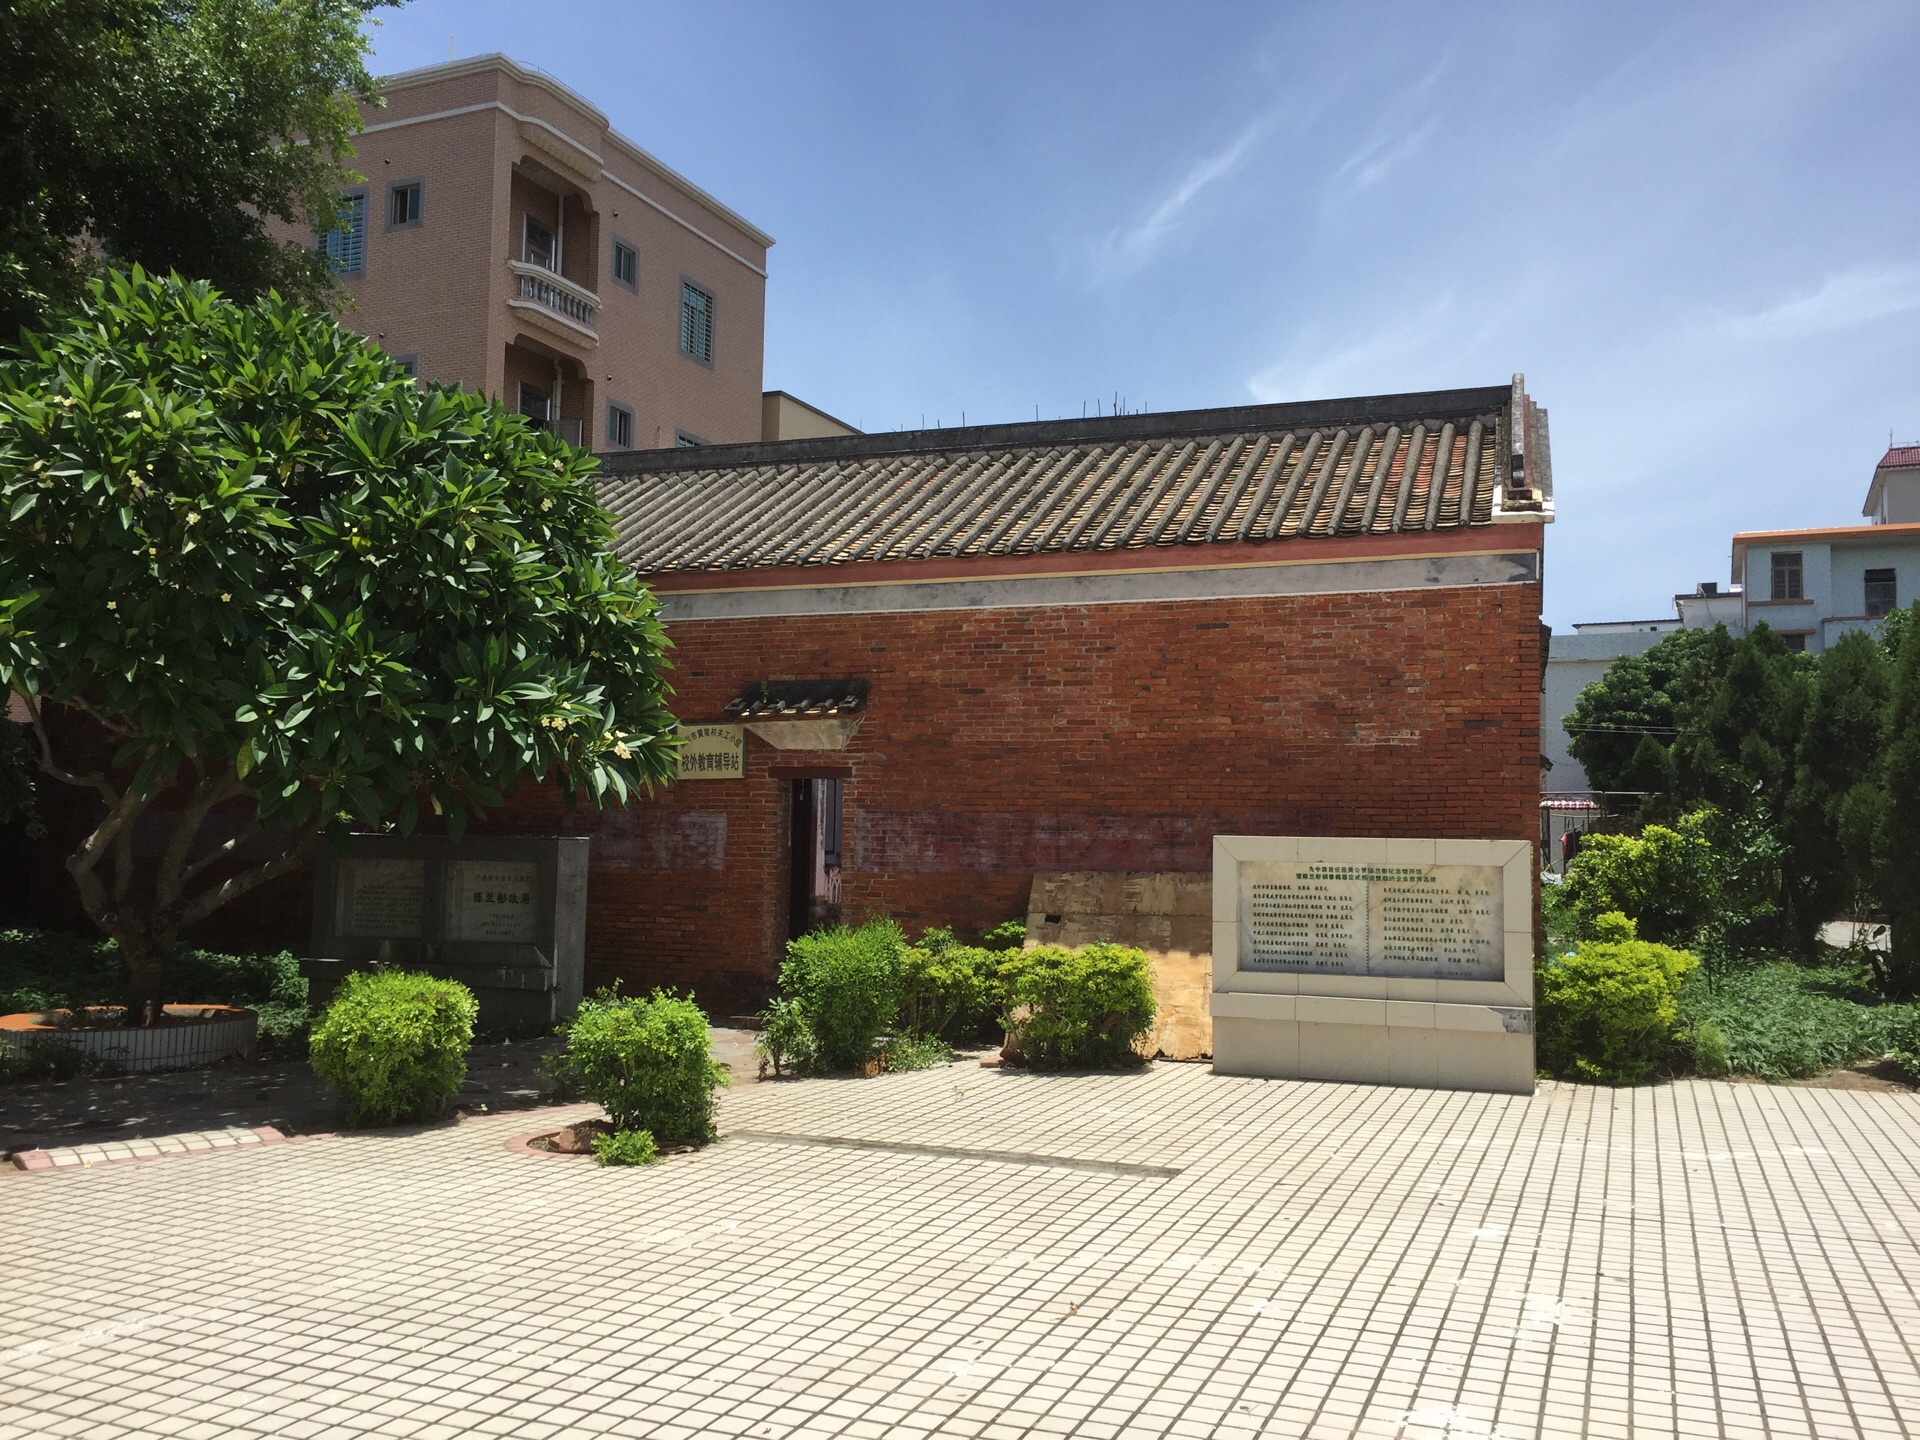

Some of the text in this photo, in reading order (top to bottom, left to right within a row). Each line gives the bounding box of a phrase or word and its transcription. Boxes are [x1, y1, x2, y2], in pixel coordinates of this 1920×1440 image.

[682, 752, 739, 772] 校外教育辅导站
[474, 892, 530, 904] 陈兰彬故居
